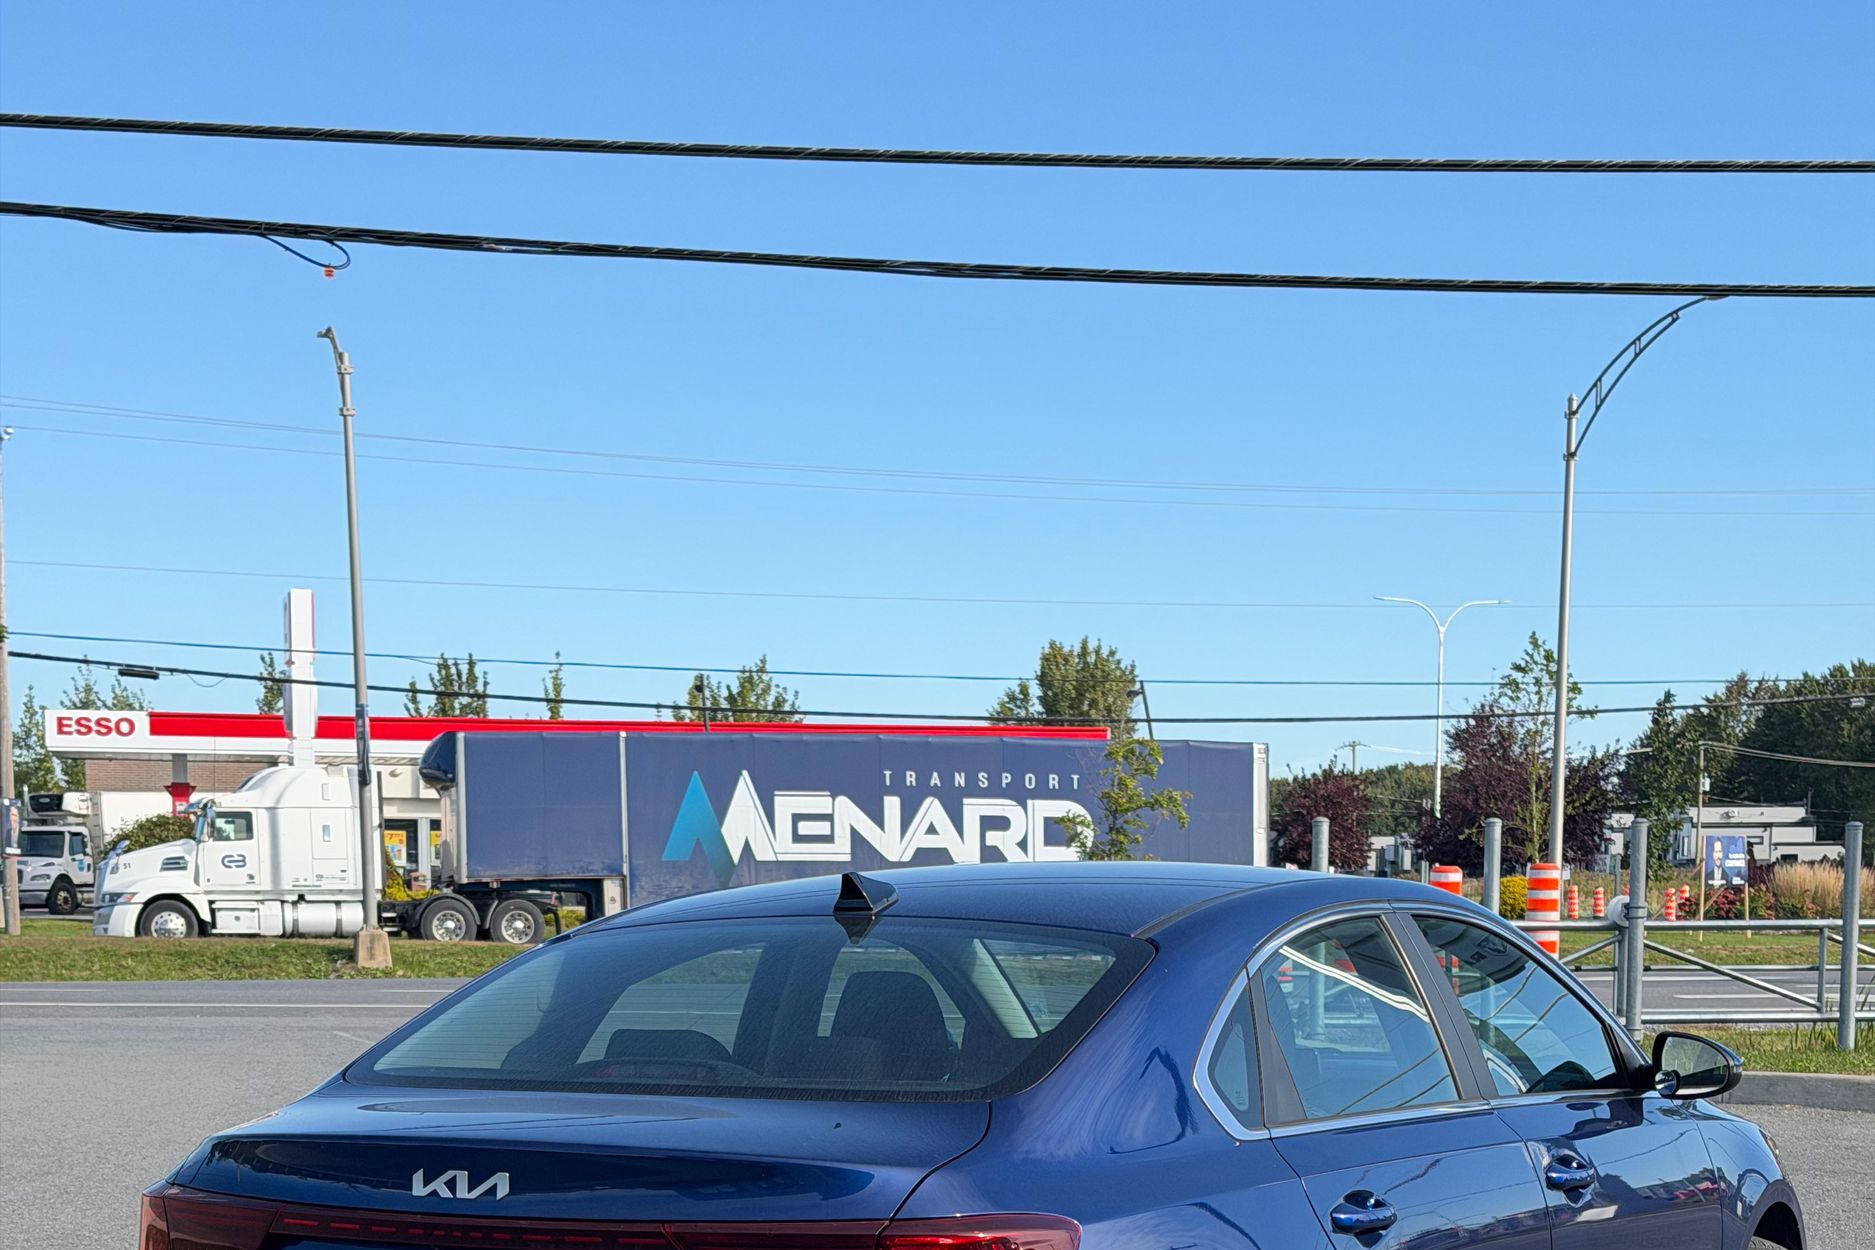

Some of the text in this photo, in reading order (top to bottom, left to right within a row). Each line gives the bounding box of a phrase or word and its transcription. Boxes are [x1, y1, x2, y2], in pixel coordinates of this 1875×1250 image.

[56, 716, 136, 737] ESSO
[883, 770, 1080, 790] TRANSPORT
[661, 769, 1095, 866] MENARD
[412, 1168, 510, 1201] KIA
